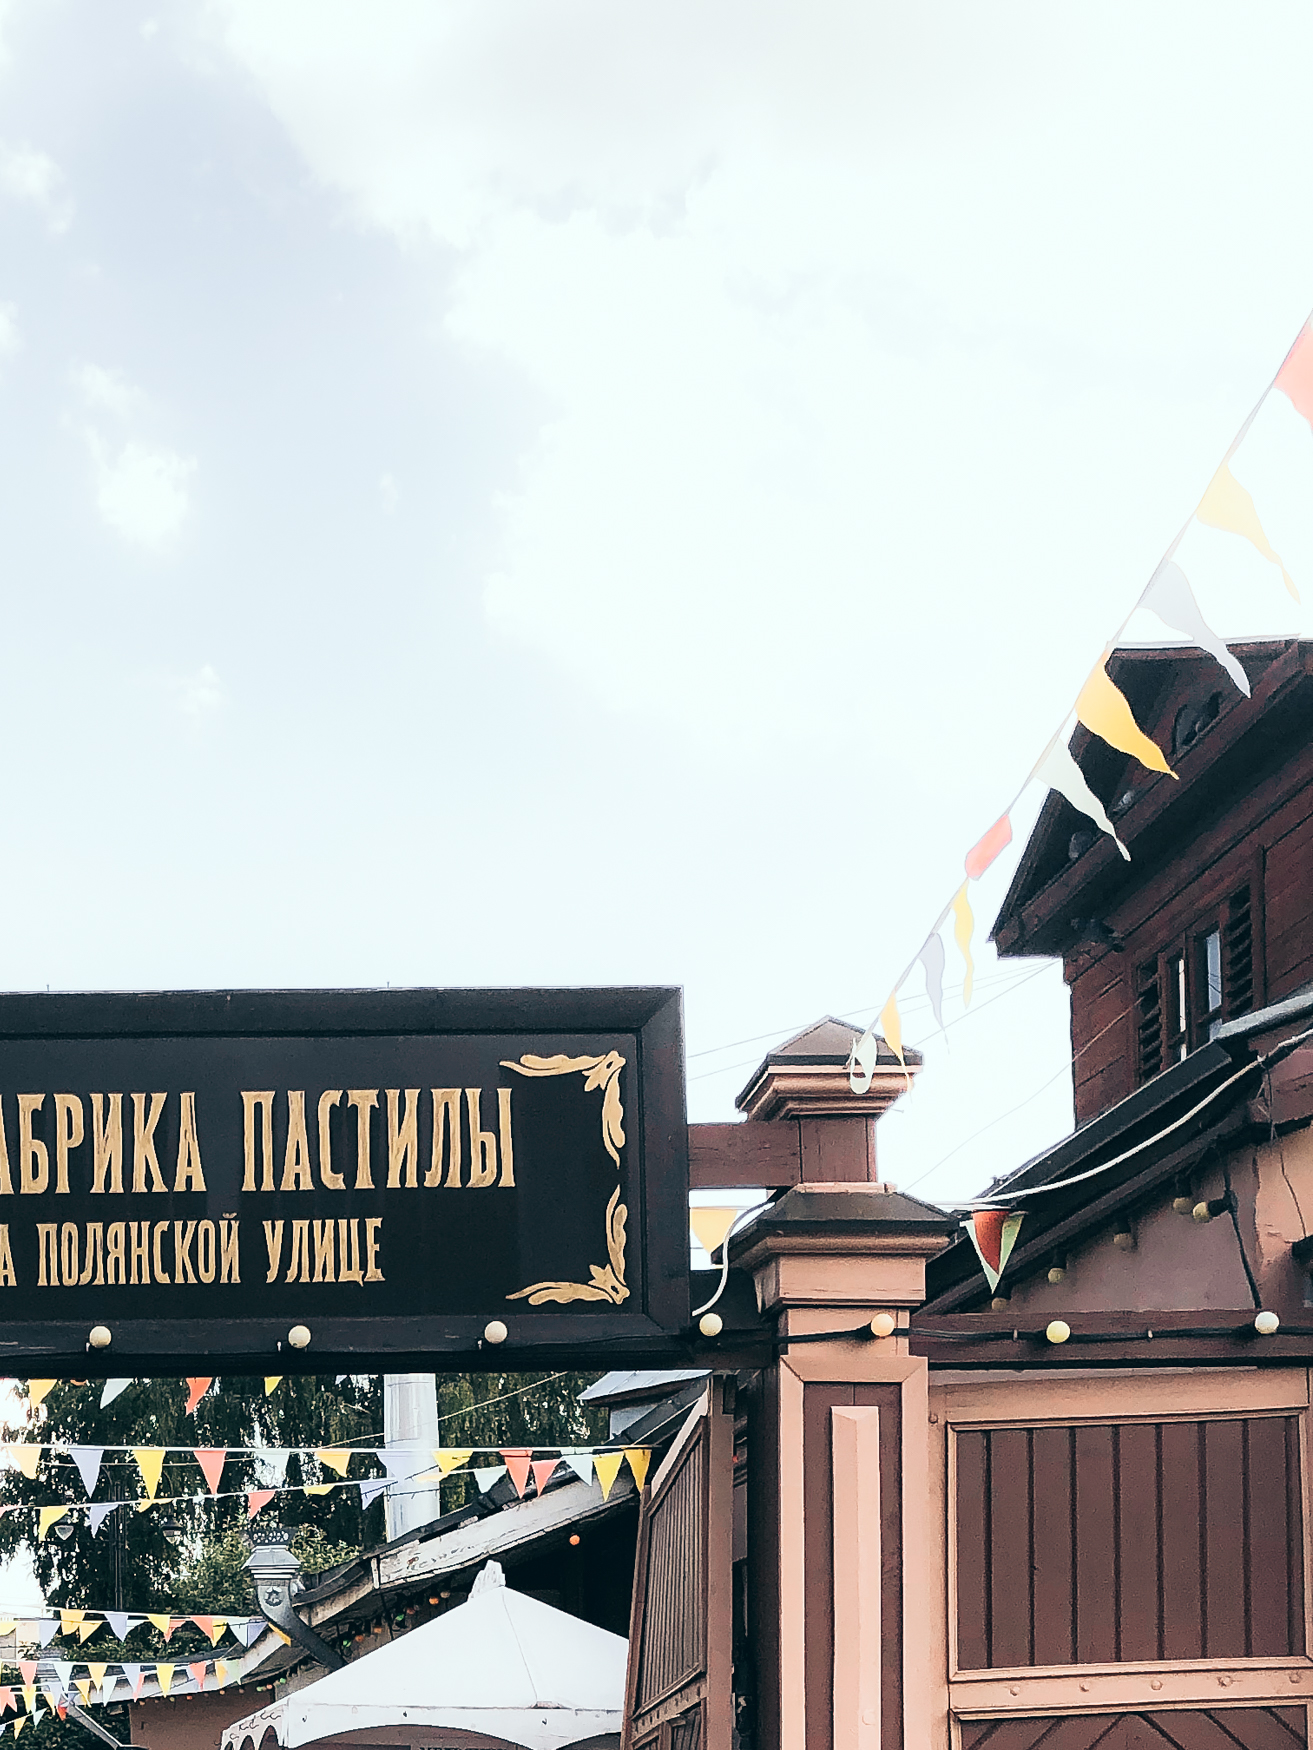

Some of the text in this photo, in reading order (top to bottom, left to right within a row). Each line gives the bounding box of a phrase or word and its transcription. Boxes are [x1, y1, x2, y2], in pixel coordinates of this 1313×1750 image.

[241, 1088, 515, 1191] ПАСТИЛЫ
[36, 1213, 241, 1286] ПОЛЯНСКОЙ
[263, 1218, 385, 1286] УЛИЦЕ
